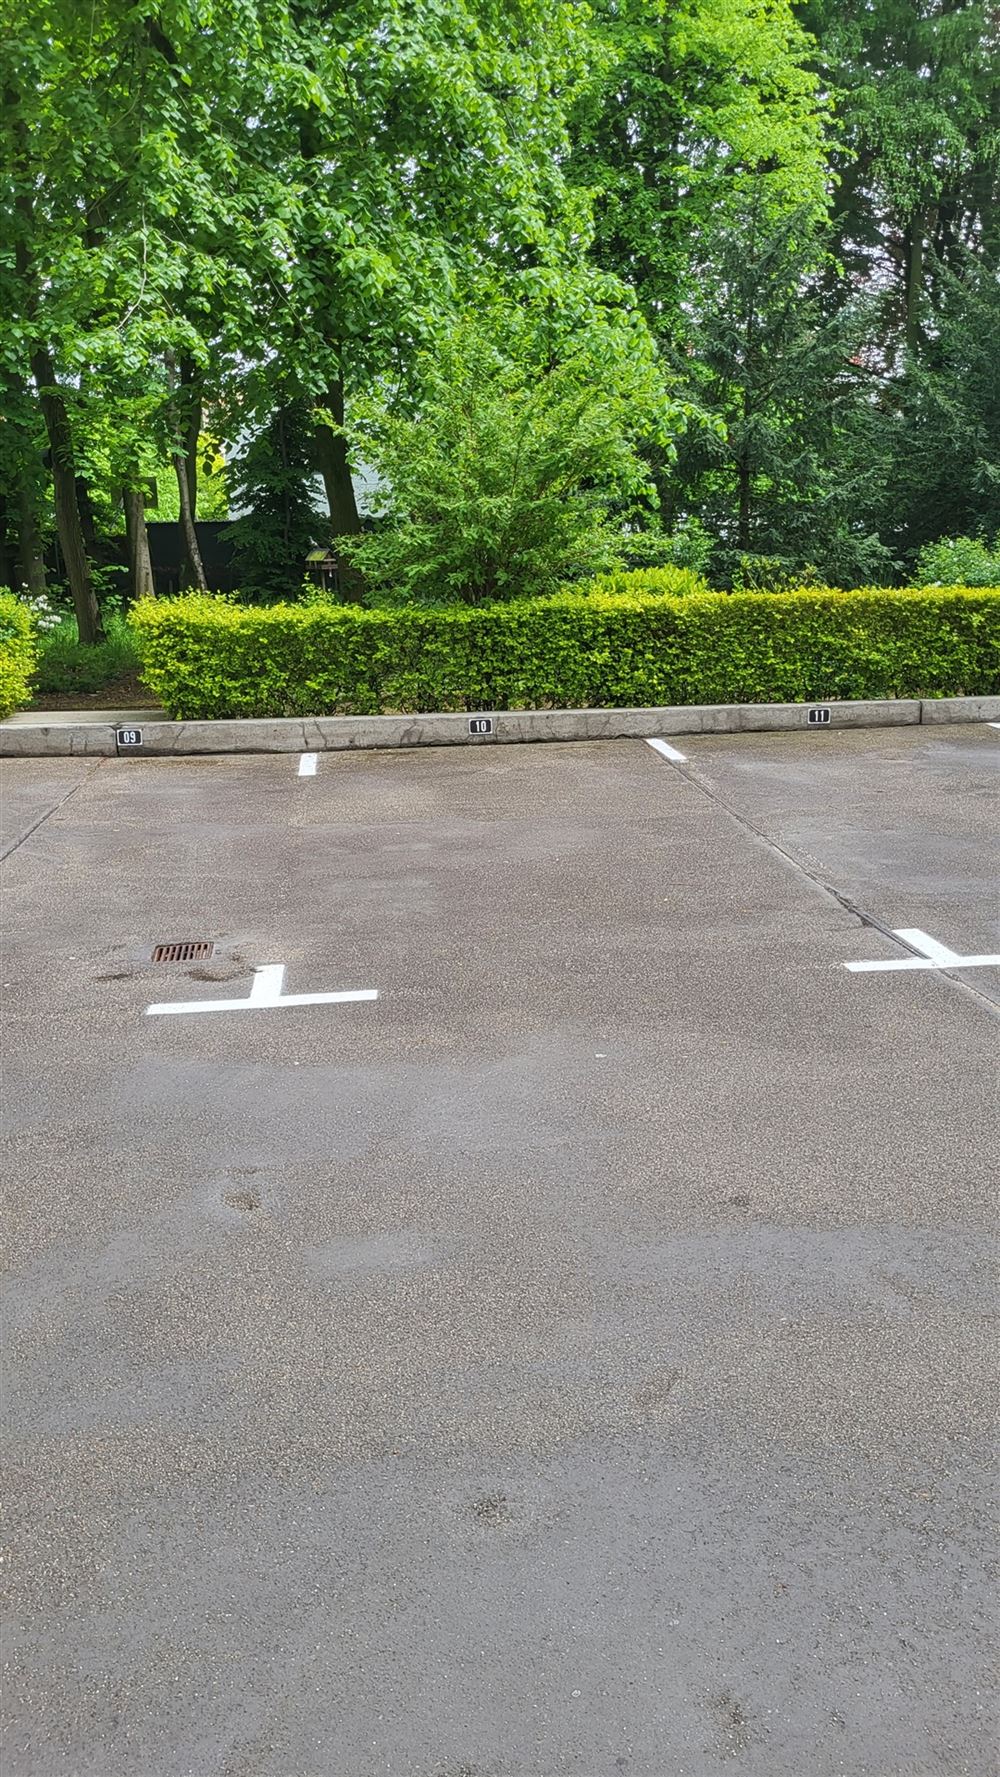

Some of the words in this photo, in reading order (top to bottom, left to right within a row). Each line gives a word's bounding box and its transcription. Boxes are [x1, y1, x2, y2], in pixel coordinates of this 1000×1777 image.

[814, 710, 824, 722] 11
[475, 720, 487, 732] 10
[123, 731, 136, 743] 09
